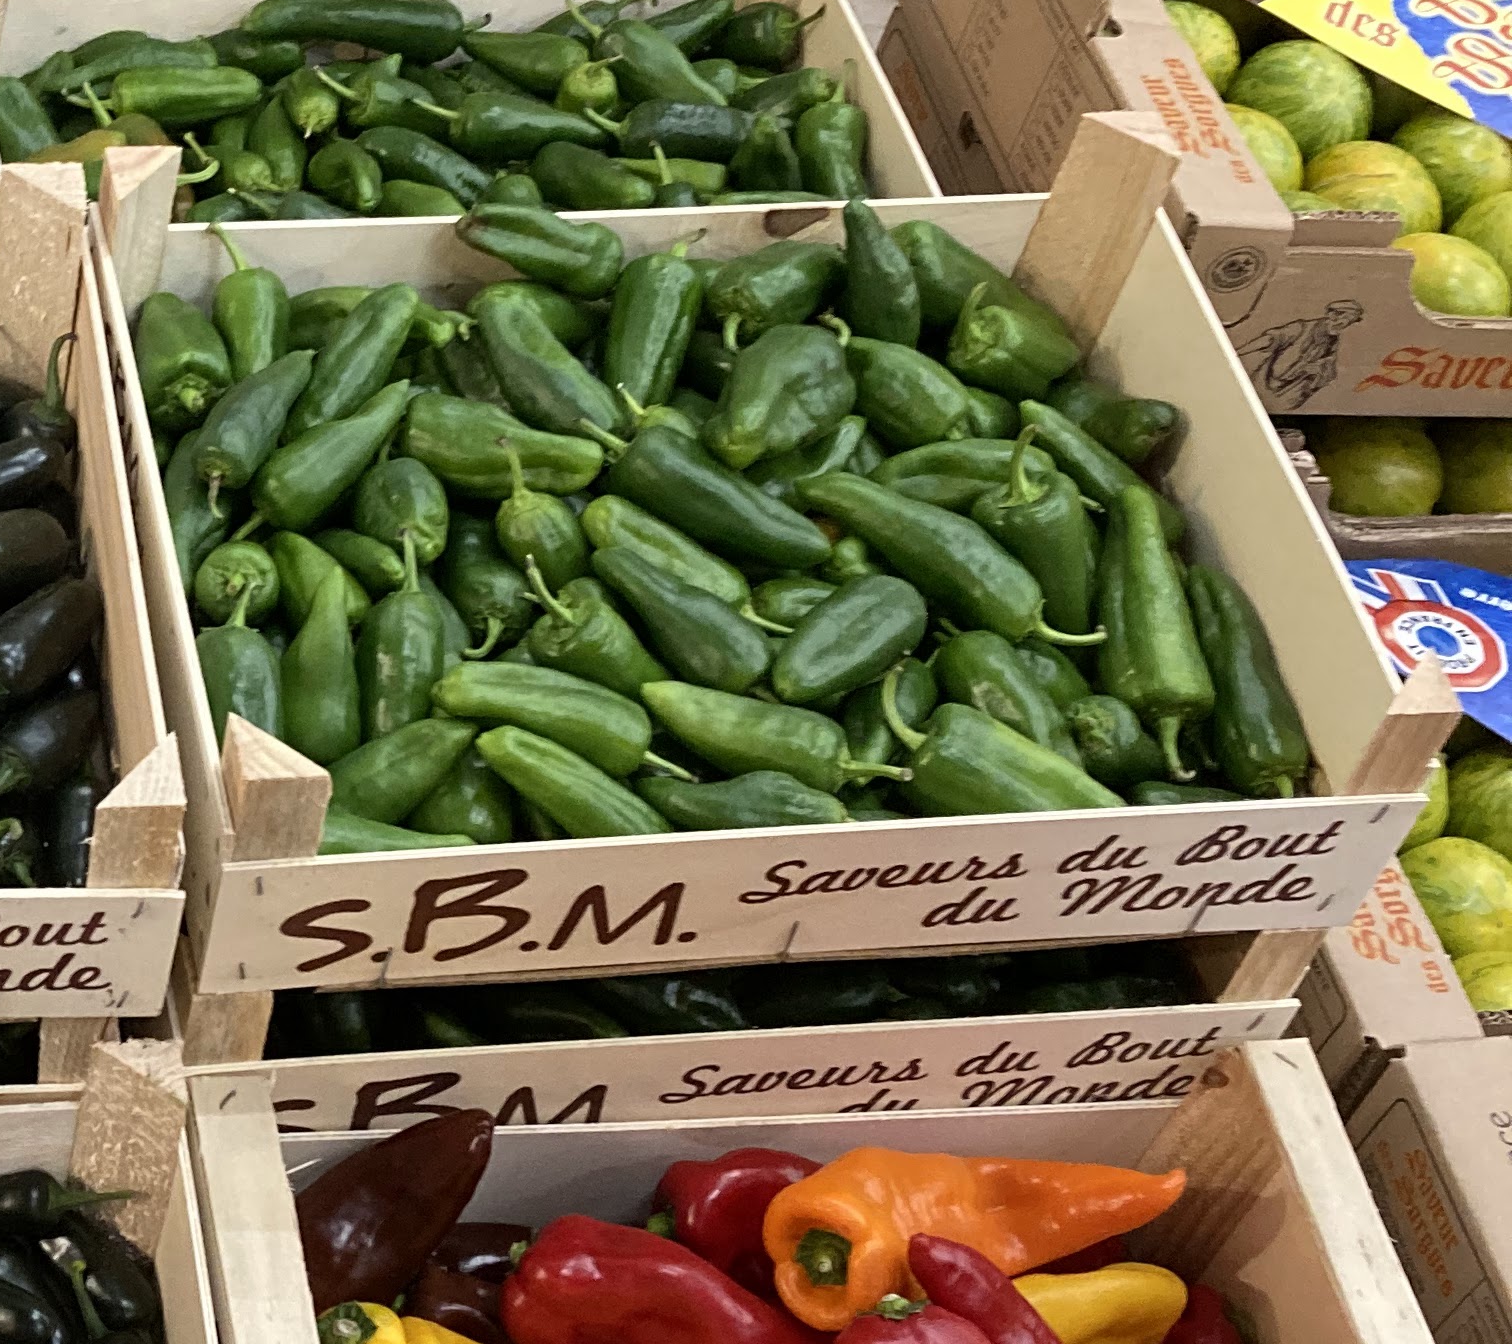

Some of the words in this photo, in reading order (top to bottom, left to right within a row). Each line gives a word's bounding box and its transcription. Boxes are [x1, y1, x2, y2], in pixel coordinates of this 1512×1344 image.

[1324, 0, 1400, 48] des
[738, 856, 1028, 906] Saveurs
[1056, 834, 1146, 874] du
[1174, 820, 1342, 866] Bout
[922, 888, 1018, 930] du
[1058, 866, 1316, 918] Monde
[280, 868, 696, 974] S.B.M.
[660, 1056, 923, 1104] Saveurs
[956, 1042, 1044, 1076] du
[1076, 1026, 1220, 1066] Bout
